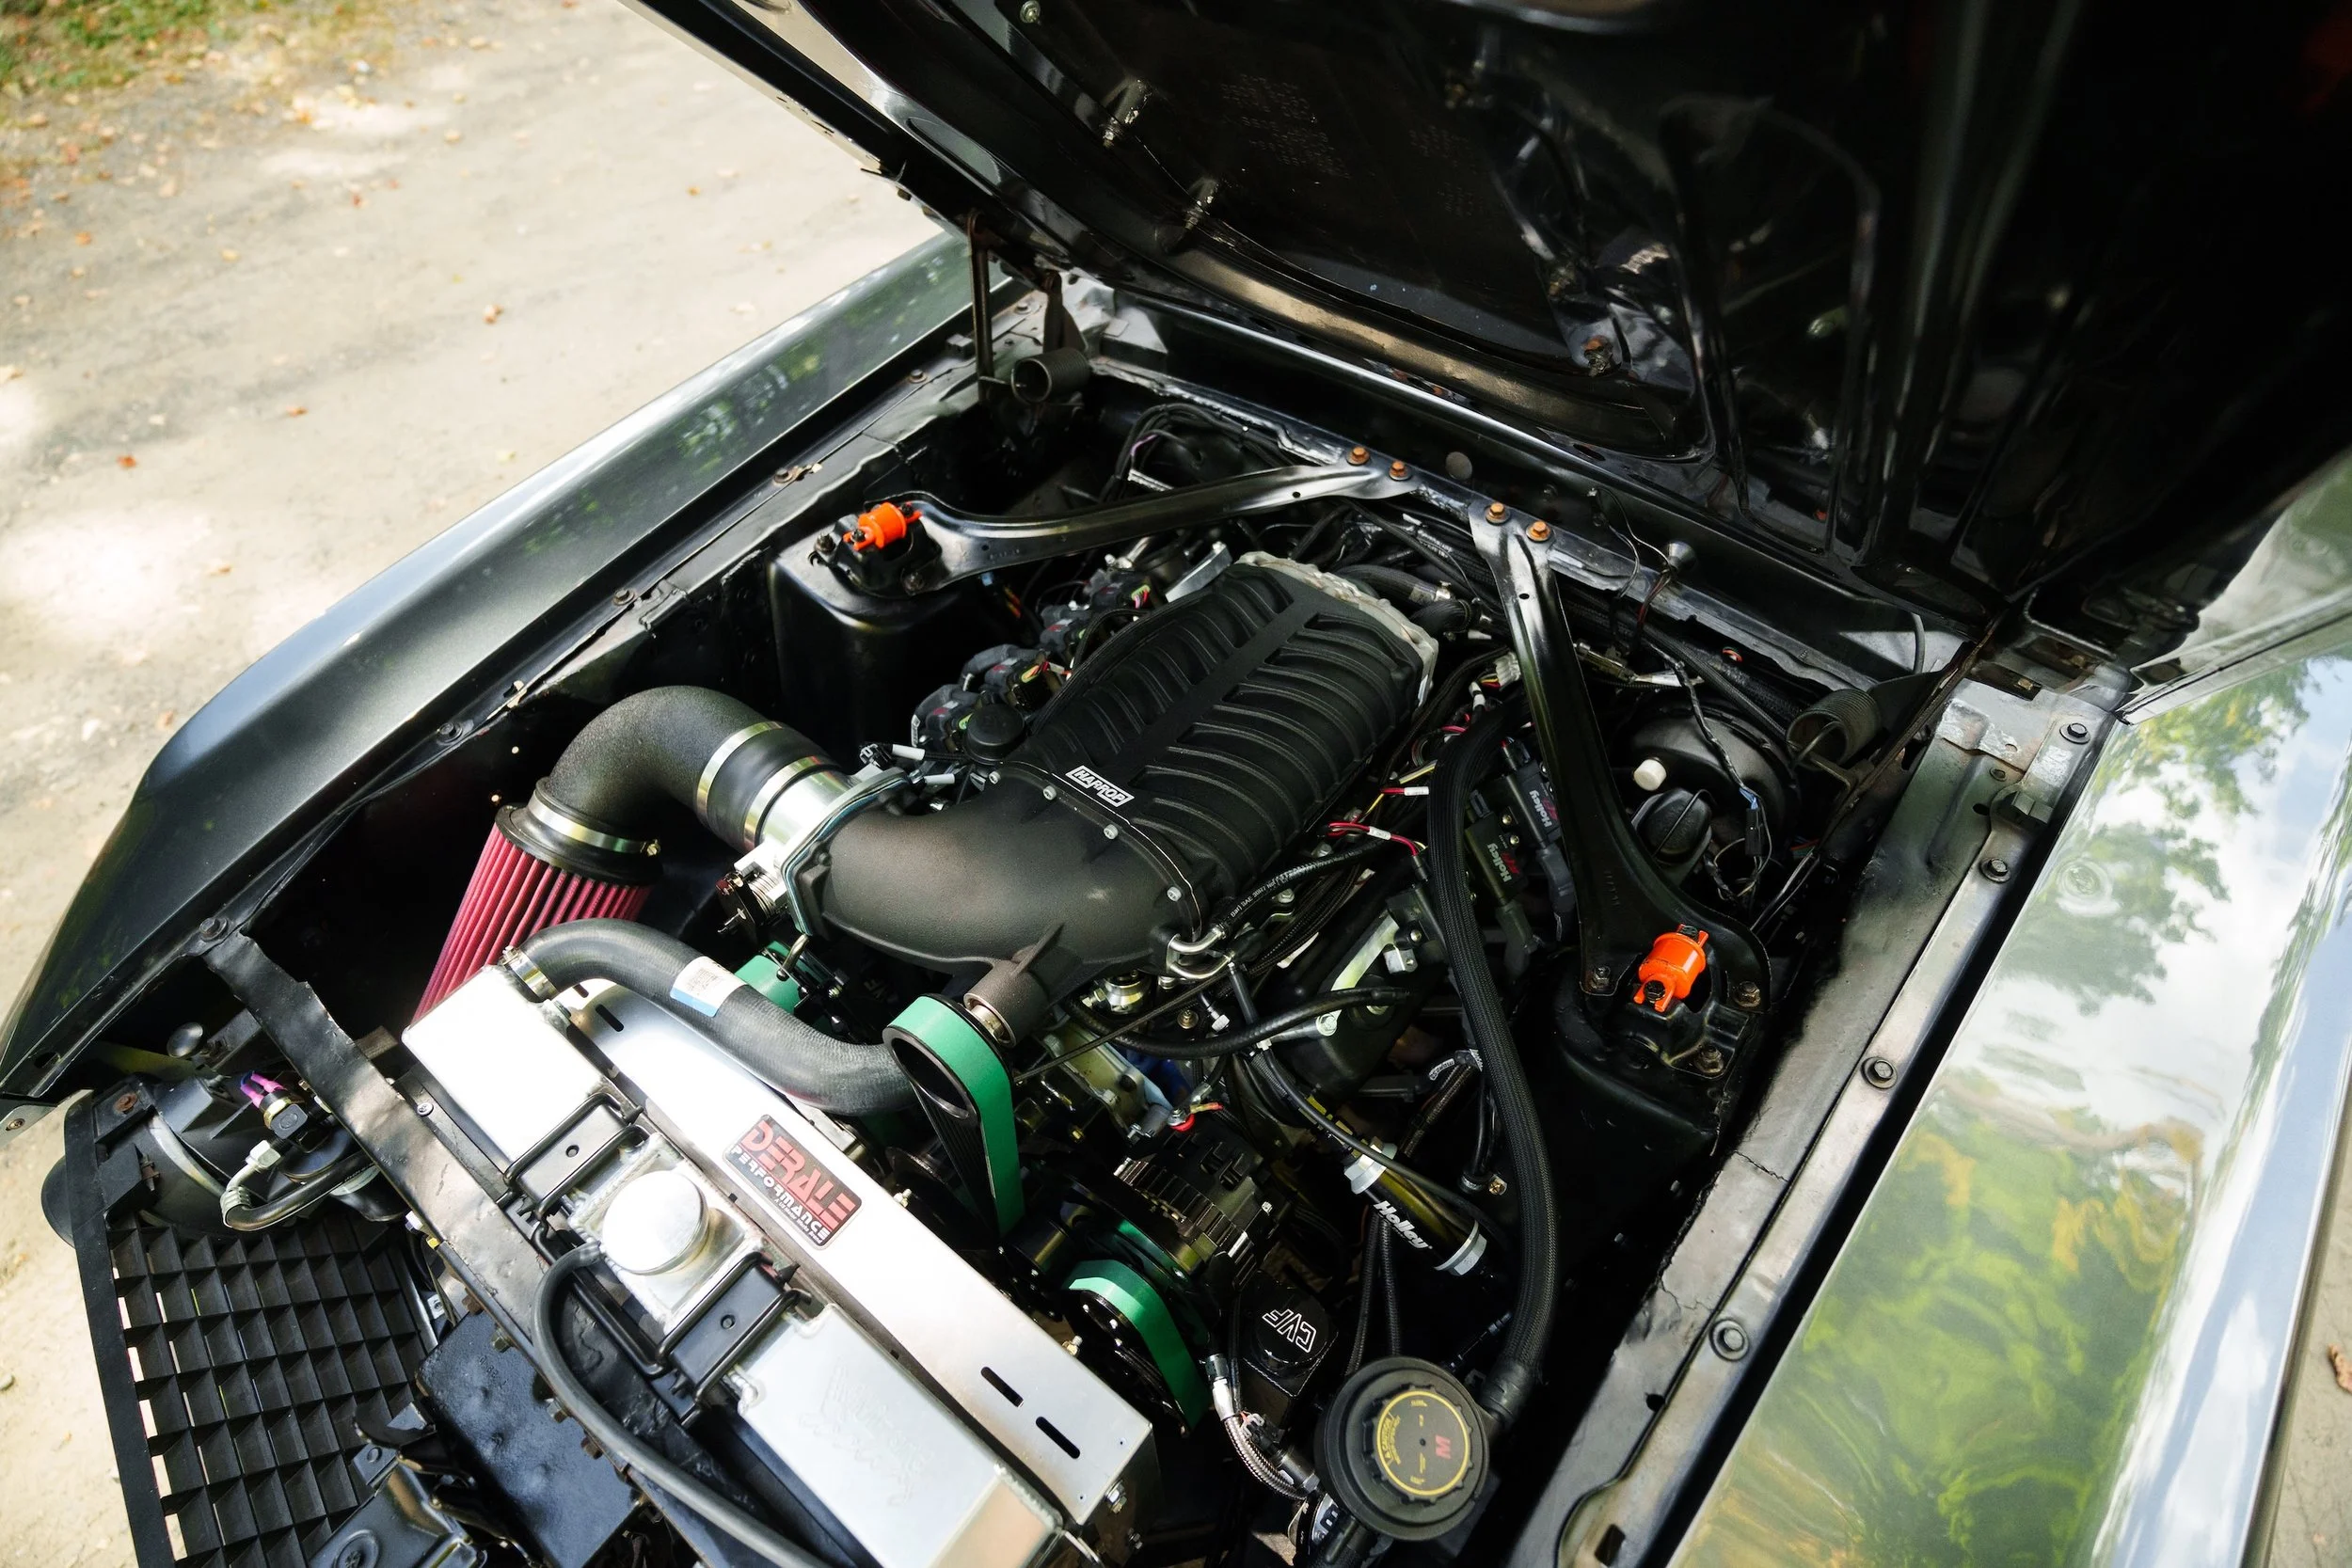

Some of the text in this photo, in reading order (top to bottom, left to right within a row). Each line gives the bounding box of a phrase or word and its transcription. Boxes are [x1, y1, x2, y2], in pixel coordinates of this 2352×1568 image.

[1073, 769, 1126, 801] HARROP
[1529, 789, 1552, 828] Holley
[1487, 843, 1512, 882] Holley
[729, 1144, 831, 1241] PERFORMANCE
[739, 1119, 856, 1232] DERALE
[1373, 1200, 1429, 1249] Holley
